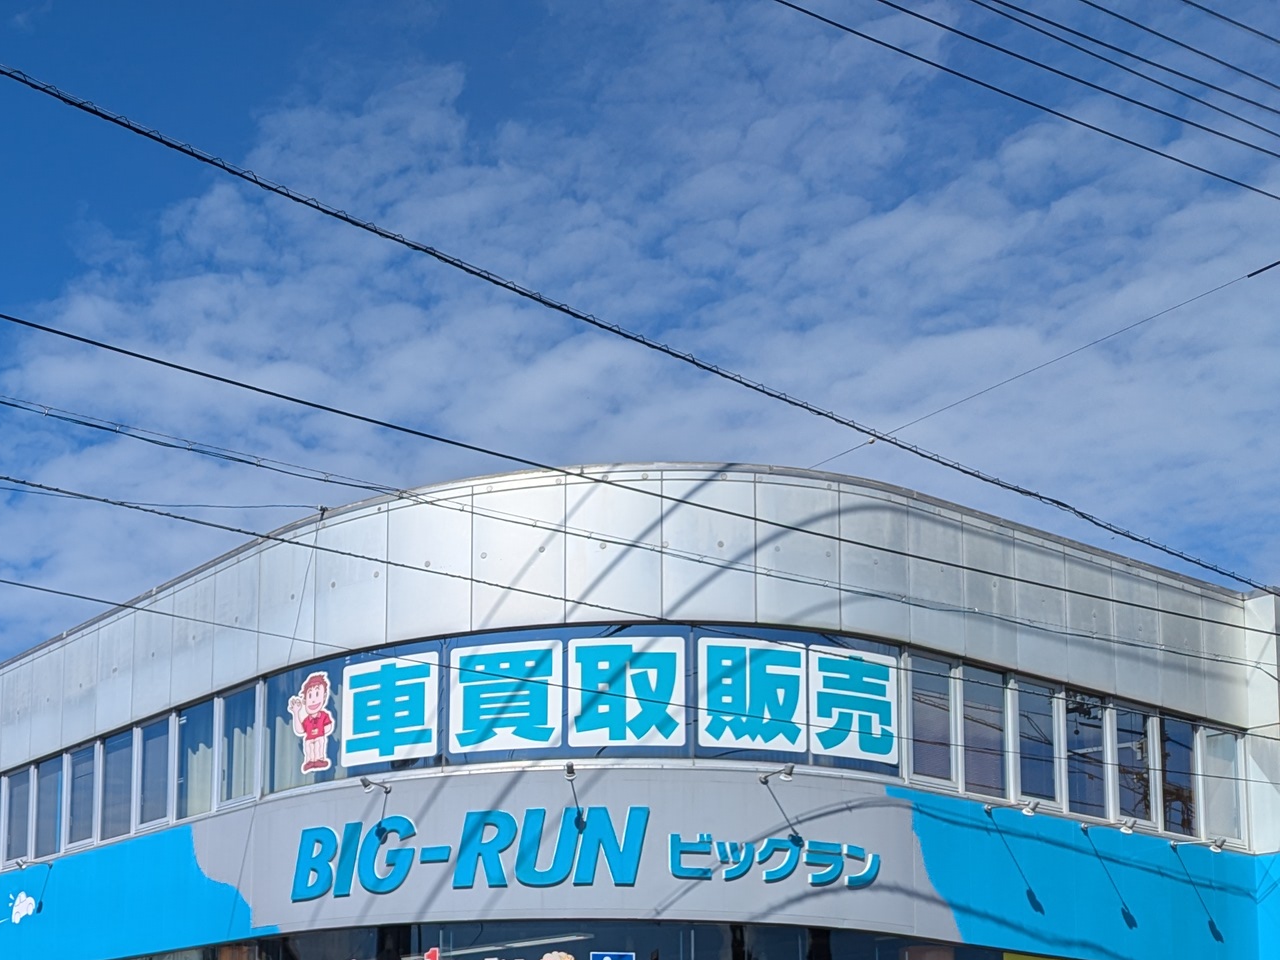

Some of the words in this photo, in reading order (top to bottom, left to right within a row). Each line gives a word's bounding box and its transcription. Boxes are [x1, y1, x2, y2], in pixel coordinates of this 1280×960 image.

[344, 643, 895, 759] 車買取販売
[291, 806, 650, 903] BIG-RUN
